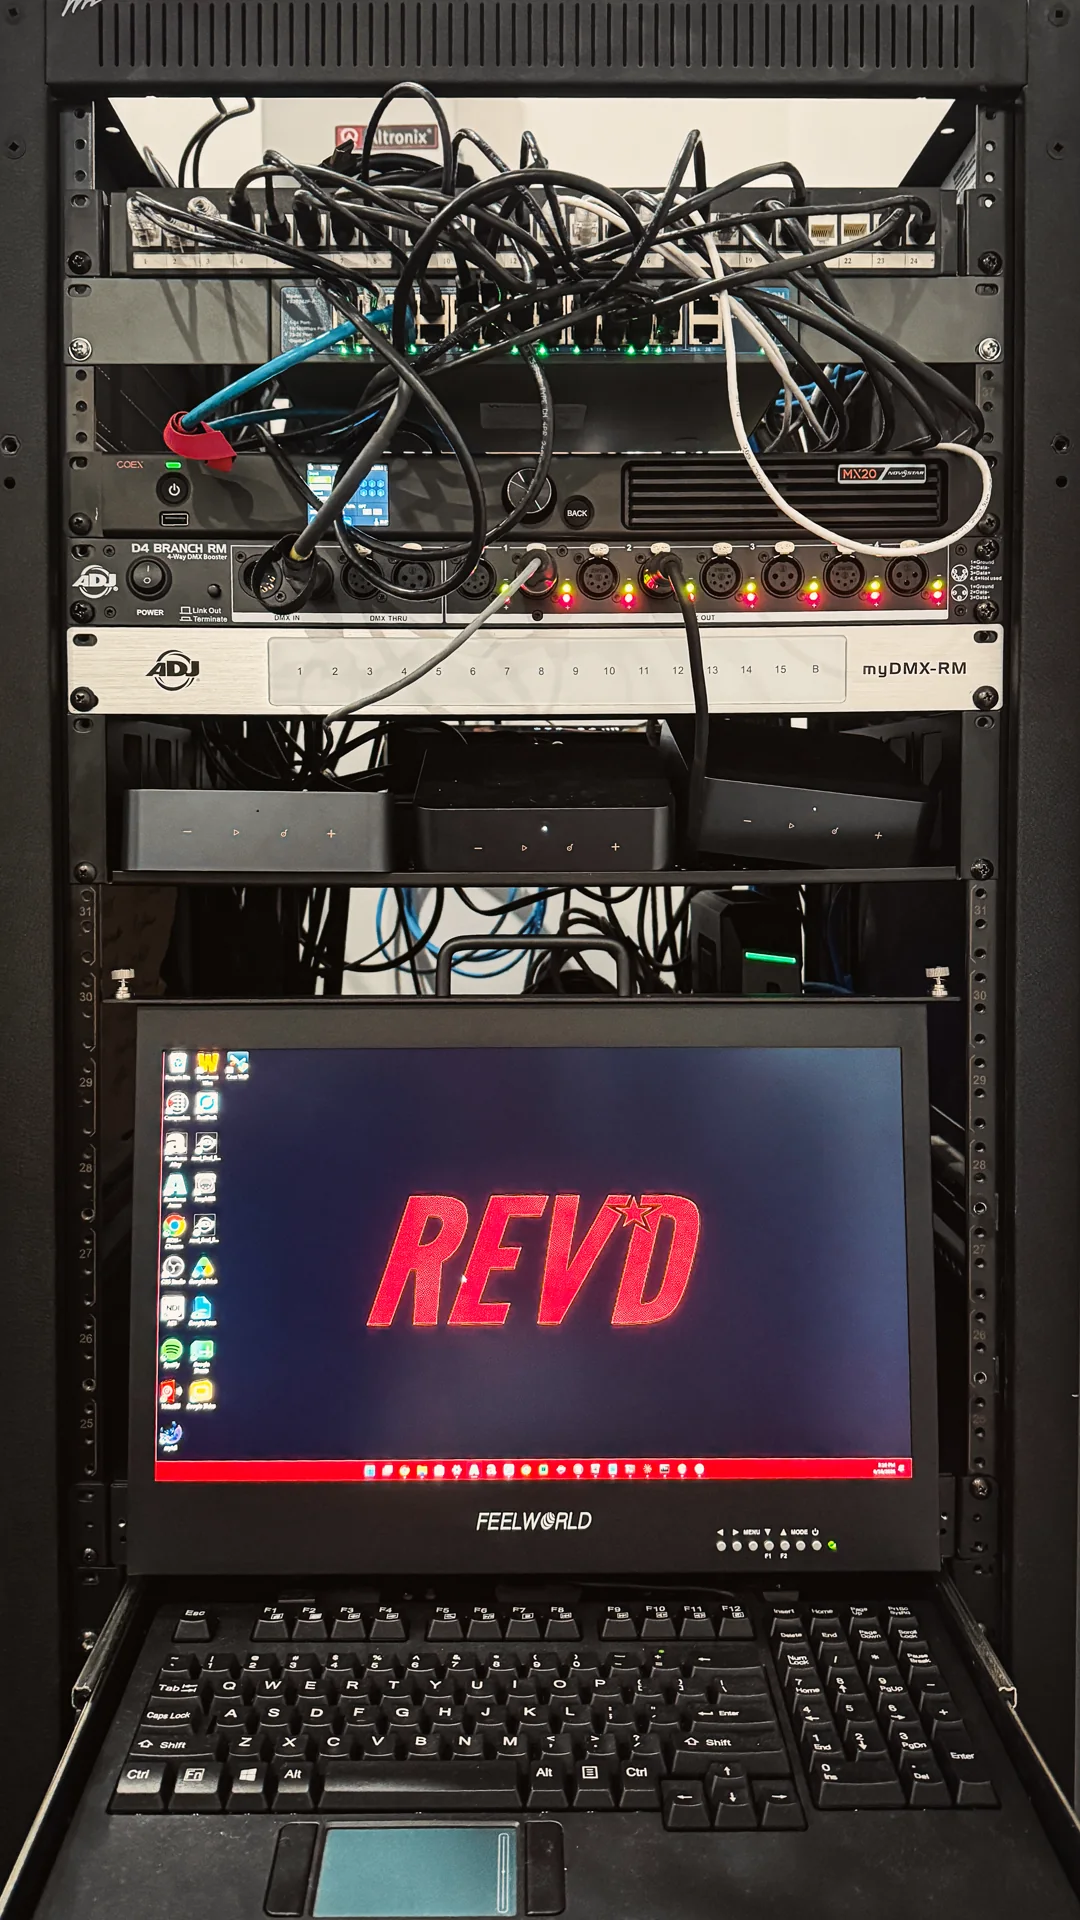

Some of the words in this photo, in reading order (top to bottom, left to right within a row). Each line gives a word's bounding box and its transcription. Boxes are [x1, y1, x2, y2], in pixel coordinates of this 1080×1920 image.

[117, 460, 144, 469] COEX
[842, 468, 877, 479] MX20
[567, 509, 588, 517] BACK
[131, 543, 150, 554] D4
[153, 543, 204, 554] BRANCH
[207, 543, 228, 554] RM
[626, 544, 632, 552] 2
[750, 542, 756, 550] 3
[72, 573, 118, 588] ADJ
[192, 606, 208, 614] Link
[209, 606, 222, 614] Out
[145, 661, 200, 676] ADJ
[297, 667, 303, 676] 1
[332, 667, 338, 676] 2
[366, 667, 372, 676] 3
[400, 667, 408, 676] 4
[436, 667, 442, 676] 5
[470, 667, 476, 676] 6
[504, 667, 510, 676] 7
[538, 667, 545, 676] 8
[572, 666, 579, 675] 9
[604, 666, 616, 675] 10
[638, 666, 650, 675] 11
[672, 666, 684, 675] 12
[706, 666, 718, 674] 13
[740, 666, 752, 674] 14
[775, 665, 787, 674] 15
[812, 665, 820, 674] B
[862, 661, 968, 678] myDMX-RM
[79, 907, 92, 916] 31
[79, 992, 92, 1002] 30
[974, 990, 987, 1000] 30
[79, 1078, 93, 1087] 29
[973, 1075, 987, 1085] 29
[80, 1163, 92, 1172] 28
[79, 1249, 93, 1258] 27
[973, 1244, 986, 1254] 27
[366, 1194, 700, 1326] REVD
[80, 1334, 92, 1344] 26
[80, 1419, 94, 1428] 25
[476, 1512, 593, 1531] FEELWORLD
[264, 1681, 282, 1690] W
[304, 1681, 317, 1690] E
[346, 1681, 359, 1689] R
[388, 1681, 400, 1689] T
[429, 1680, 443, 1689] Y
[471, 1680, 484, 1689] U
[512, 1680, 518, 1688] I
[552, 1680, 567, 1688] O
[594, 1680, 606, 1688] P
[836, 1677, 845, 1685] 8
[878, 1677, 887, 1685] 9
[158, 1684, 180, 1692] Tab
[222, 1682, 237, 1690] Q
[267, 1708, 280, 1717] S
[310, 1708, 324, 1717] D
[353, 1708, 365, 1717] F
[395, 1708, 410, 1717] G
[438, 1708, 452, 1717] H
[480, 1708, 492, 1716] J
[523, 1708, 537, 1716] K
[565, 1708, 575, 1716] L
[802, 1706, 812, 1714] 4
[845, 1704, 854, 1712] 5
[888, 1704, 898, 1712] 6
[146, 1711, 169, 1720] Caps
[170, 1711, 191, 1719] Lock
[224, 1709, 238, 1717] A
[812, 1734, 820, 1742] 1
[854, 1732, 865, 1741] 2
[898, 1732, 909, 1740] 3
[159, 1741, 187, 1749] Shift
[238, 1738, 252, 1746] Z
[282, 1737, 298, 1746] X
[326, 1737, 341, 1746] C
[372, 1737, 385, 1746] V
[415, 1737, 428, 1746] B
[458, 1737, 472, 1746] N
[502, 1736, 518, 1746] M
[705, 1738, 732, 1747] Shift
[901, 1742, 927, 1750] PgDn
[626, 1766, 648, 1778] Ctrl
[821, 1763, 831, 1772] 0
[126, 1768, 150, 1780] Ctrl
[186, 1770, 202, 1780] Fn
[284, 1768, 302, 1779] Alt
[536, 1767, 553, 1778] Alt
[823, 1773, 839, 1781] Ins
[914, 1772, 930, 1780] Del
